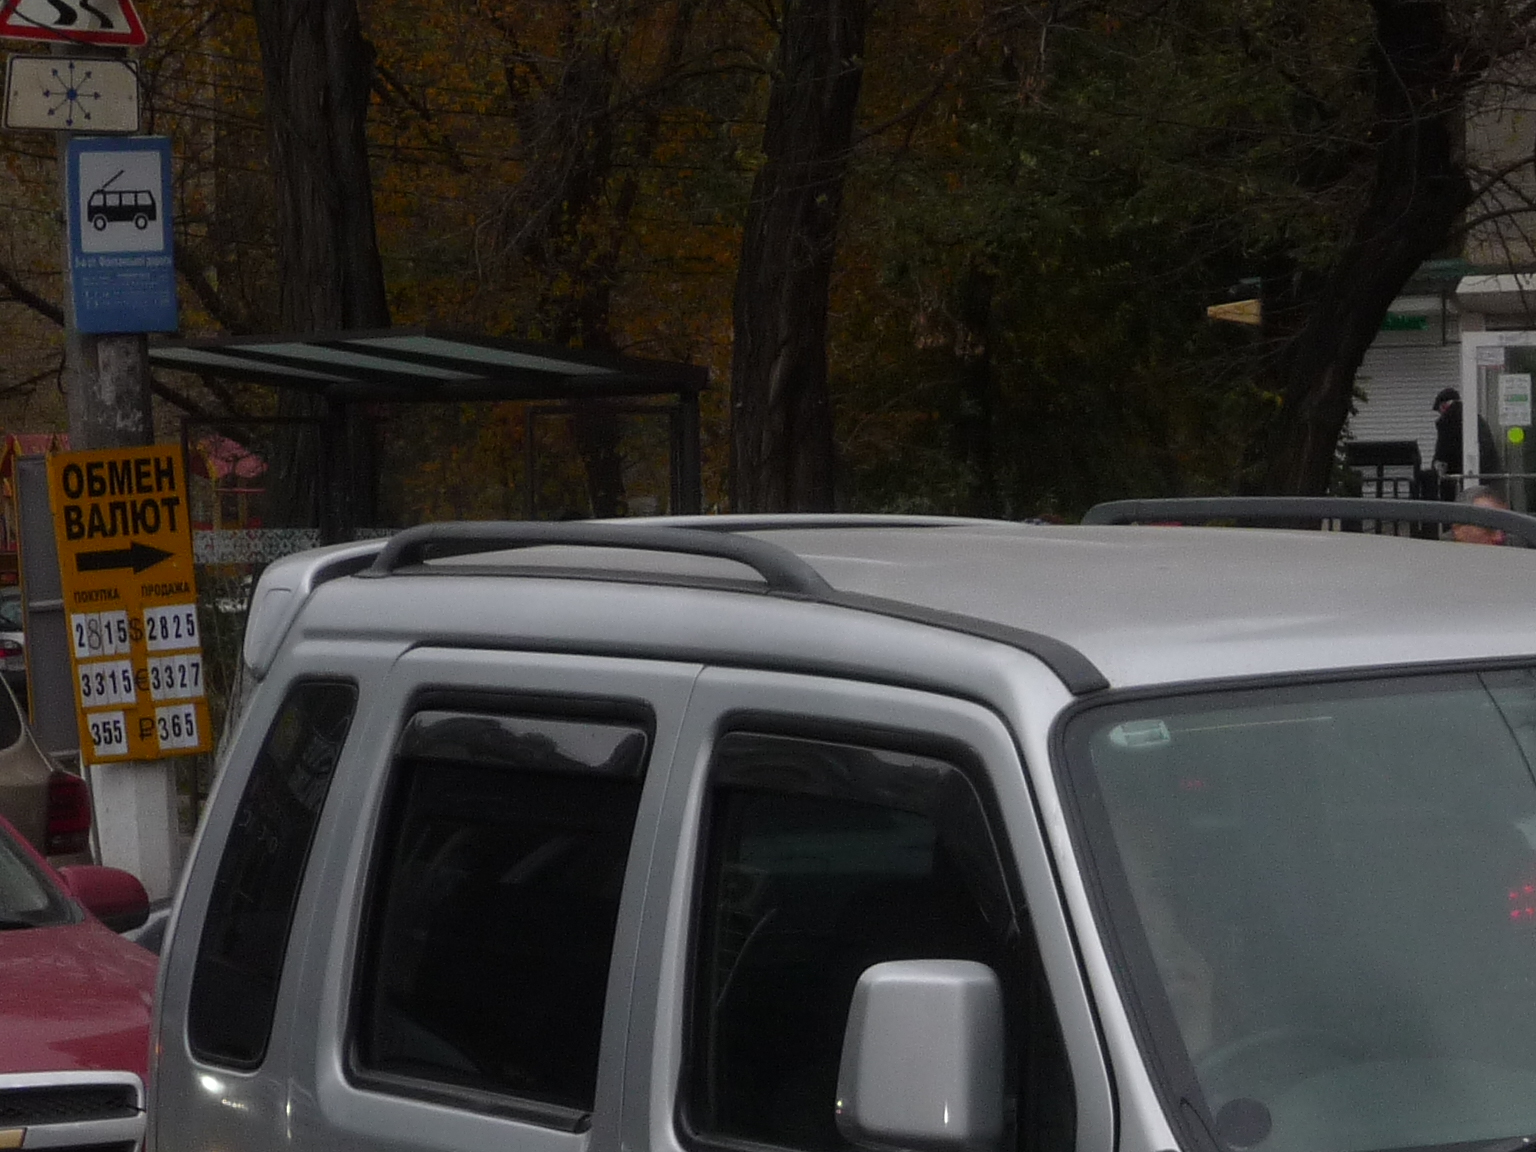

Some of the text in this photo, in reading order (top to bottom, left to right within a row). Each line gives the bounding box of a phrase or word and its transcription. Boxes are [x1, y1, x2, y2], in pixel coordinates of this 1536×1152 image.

[62, 456, 176, 499] ОБМЕН
[64, 496, 181, 541] ВАЛЮТ
[74, 581, 191, 603] ПОКУПКА ПРОДАЖА
[75, 615, 127, 651] 2815
[147, 612, 195, 642] 2825
[81, 668, 133, 697] 3315
[151, 661, 201, 689] 3327
[91, 718, 123, 746] 355
[159, 713, 195, 741] 365
